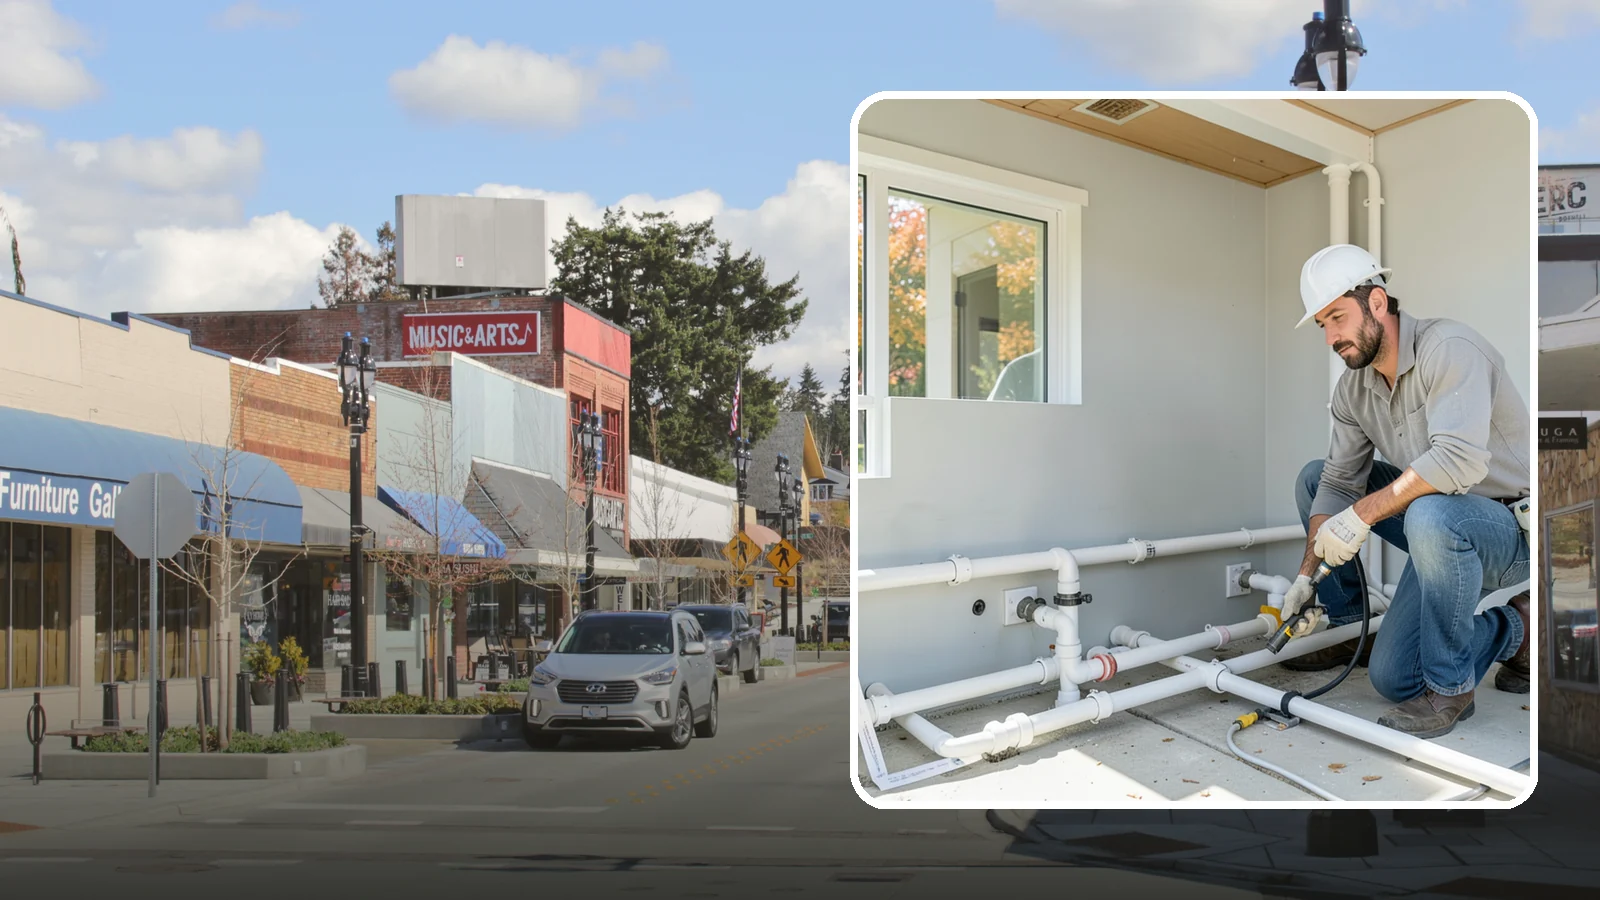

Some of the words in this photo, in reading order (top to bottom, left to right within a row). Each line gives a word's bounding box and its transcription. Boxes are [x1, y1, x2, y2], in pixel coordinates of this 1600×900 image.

[409, 323, 519, 348] MUSIC&ARTS
[1540, 427, 1577, 436] UGA
[0, 472, 79, 515] Furniture
[89, 482, 121, 519] Gal
[453, 563, 480, 574] SUSHI
